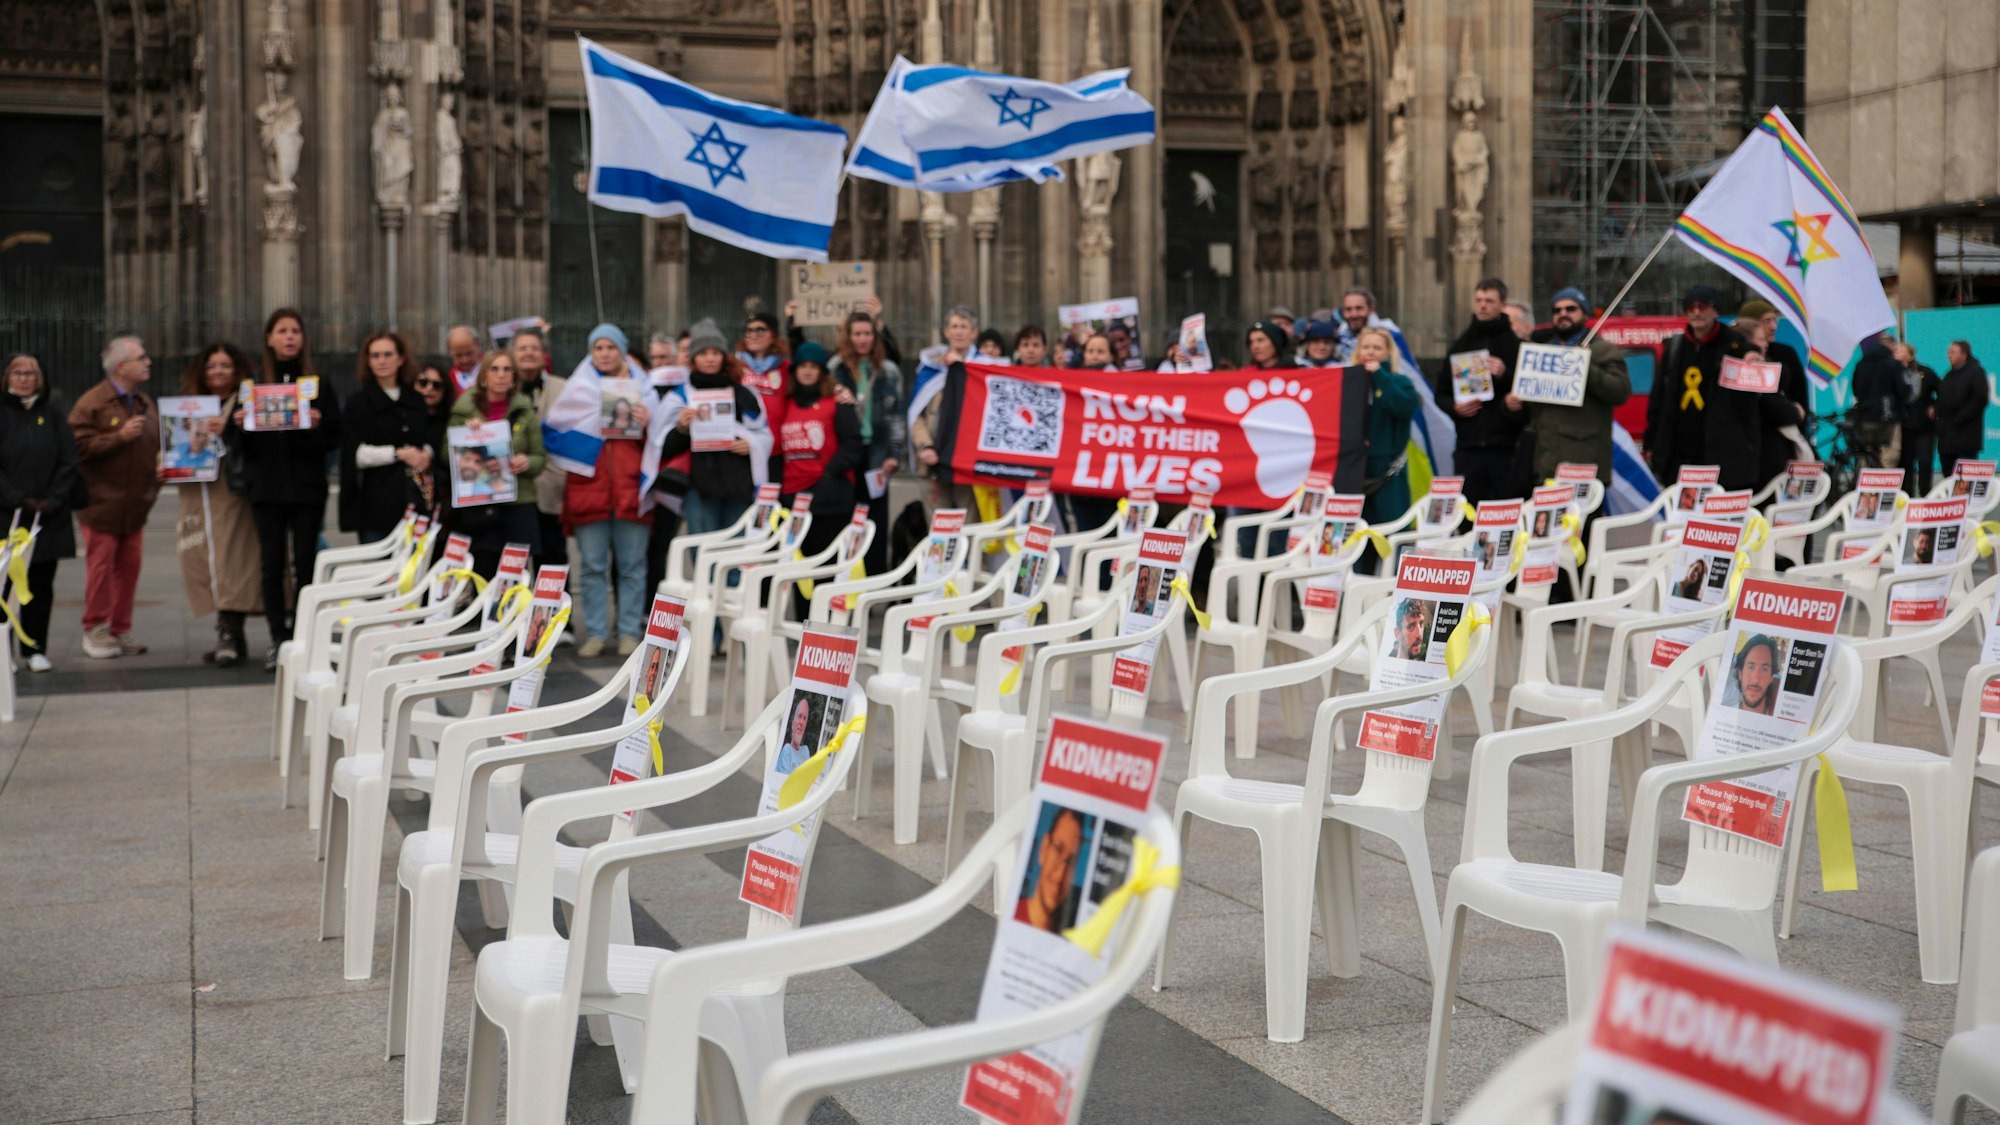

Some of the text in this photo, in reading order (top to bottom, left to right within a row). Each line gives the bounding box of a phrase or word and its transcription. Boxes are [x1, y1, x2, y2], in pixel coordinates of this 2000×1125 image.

[1081, 387, 1187, 423] RUN
[1081, 424, 1220, 453] FOR THEIR
[1072, 452, 1223, 495] LIVES
[1478, 508, 1519, 521] KIDNAPPED
[1706, 499, 1748, 511] KIDNAPPED
[1910, 503, 1963, 519] KIDNAPPED
[1687, 527, 1737, 545] KIDNAPPED
[1403, 565, 1470, 586] KIDNAPPED
[1743, 590, 1837, 622] KIDNAPPED
[1796, 659, 1809, 668] years
[1049, 737, 1154, 792] KIDNAPPED
[1696, 795, 1735, 813] home alive.
[1698, 784, 1767, 810] Please help bring them
[752, 859, 768, 873] Please
[768, 865, 779, 879] help
[750, 872, 776, 890] home alive.
[1609, 971, 1870, 1118] KIDNAPPED
